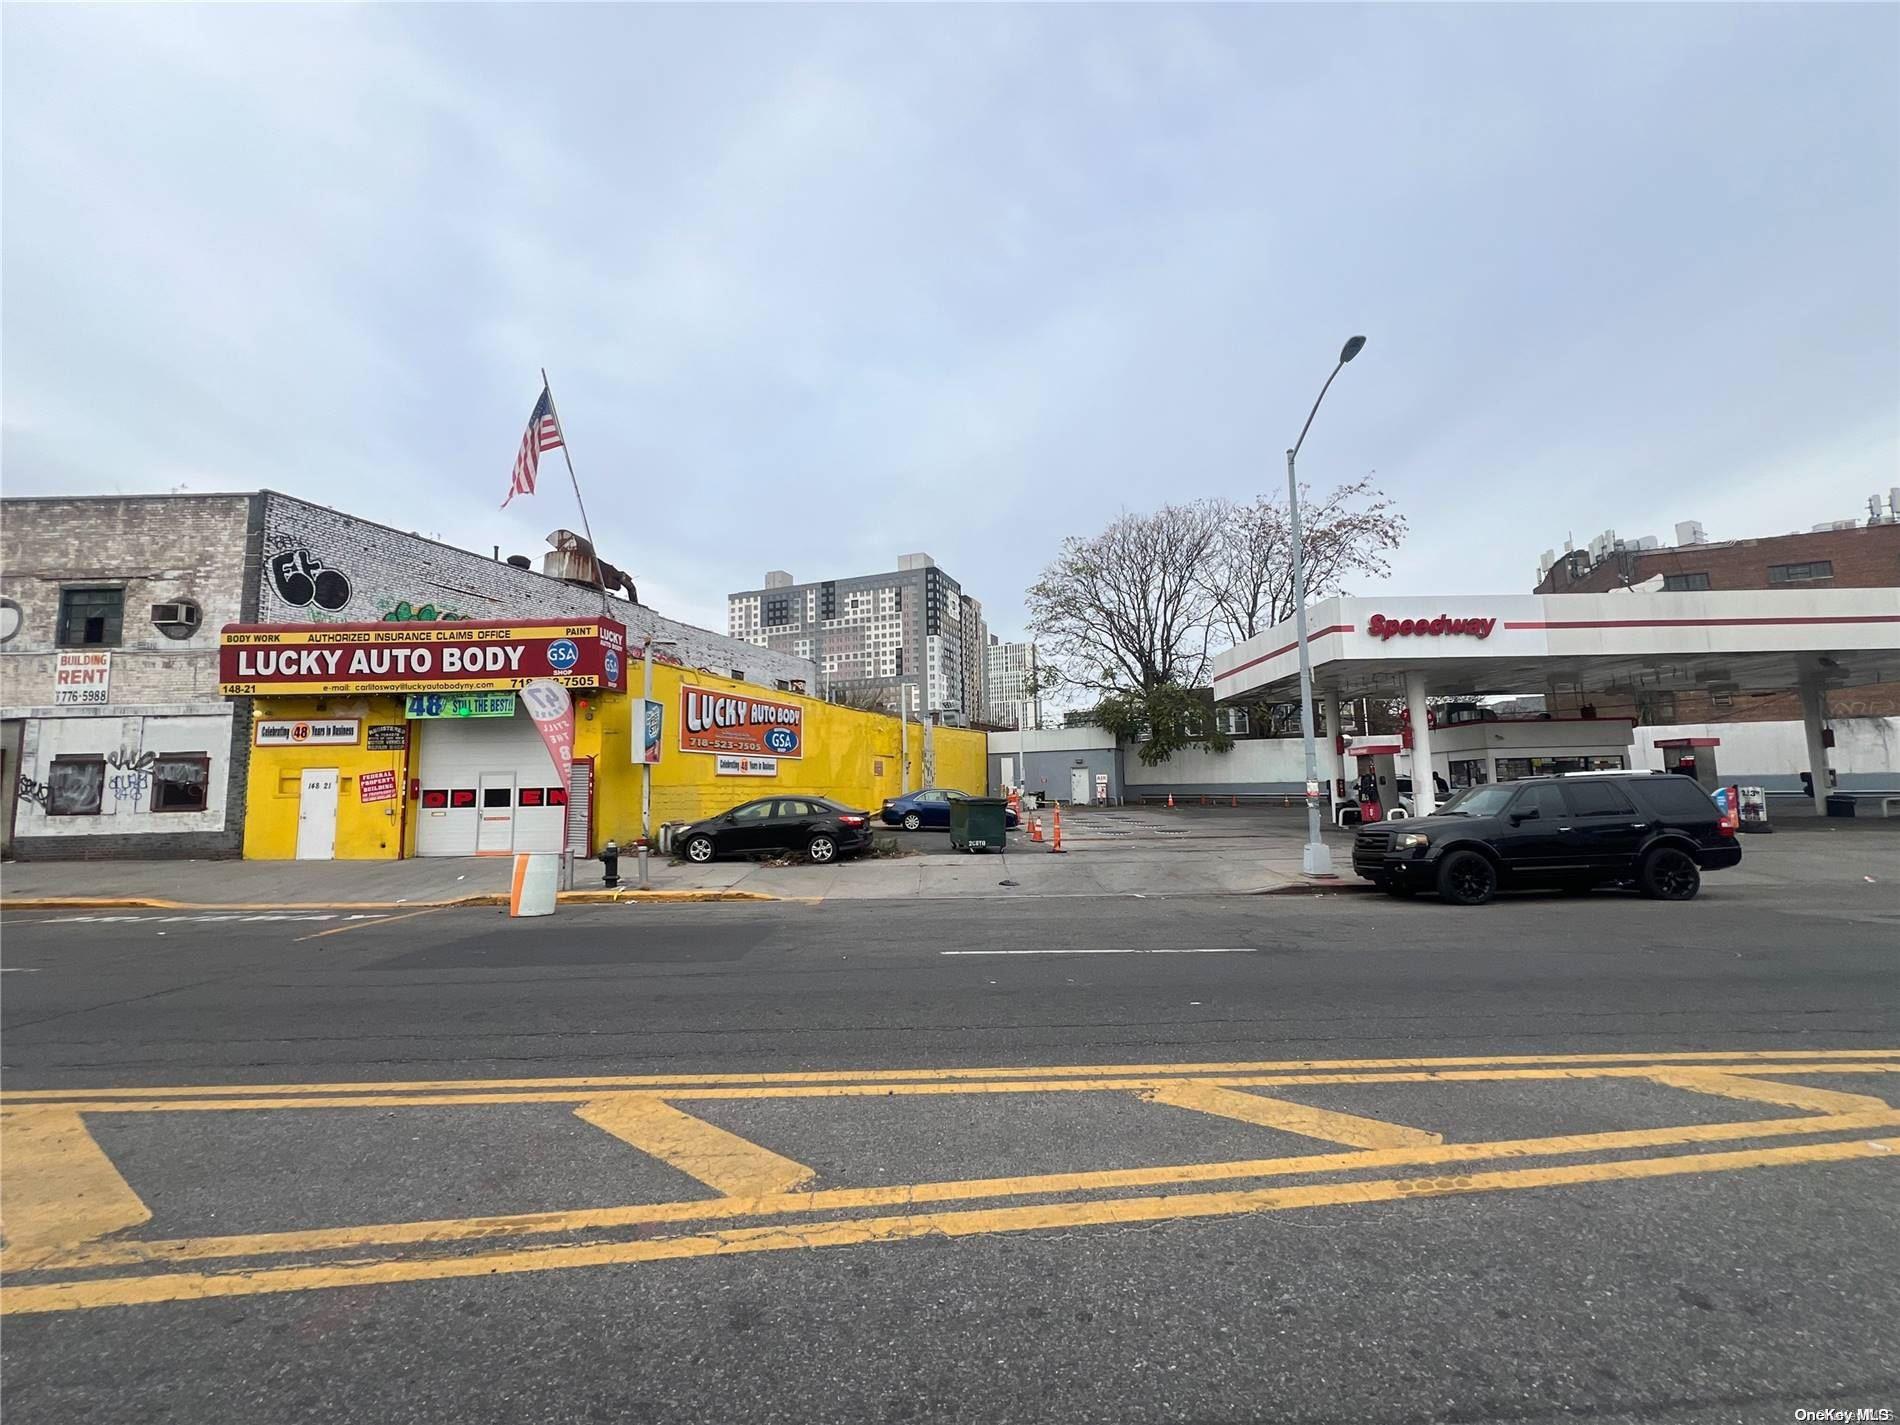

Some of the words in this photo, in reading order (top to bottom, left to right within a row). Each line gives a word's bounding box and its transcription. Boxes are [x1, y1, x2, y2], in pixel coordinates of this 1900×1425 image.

[565, 627, 592, 636] PAINT
[1368, 614, 1496, 641] Speedway
[226, 634, 251, 643] BODY
[253, 634, 281, 642] WORK
[307, 633, 370, 642] AUTHORIZED
[374, 631, 432, 641] INSURANCE
[436, 630, 473, 640] CLAIMS
[477, 630, 511, 639] OFFICE
[600, 627, 623, 646] LUCKY
[61, 655, 107, 666] BUILDING
[238, 649, 343, 676] LUCKY
[348, 648, 432, 674] AUTO
[442, 645, 526, 672] BODY
[548, 648, 576, 661] GSA
[58, 669, 107, 684] RENT
[222, 685, 256, 693] 148-21
[323, 684, 350, 692] e-mail:
[409, 694, 441, 716] 48
[475, 699, 488, 712] THE
[687, 692, 747, 732] LUCKY
[751, 703, 775, 724] AUTO
[777, 707, 800, 726] BODY
[261, 726, 289, 739] Celebrating
[294, 726, 307, 738] 48
[689, 737, 761, 751] 718-523-7505
[771, 733, 791, 747] GSA
